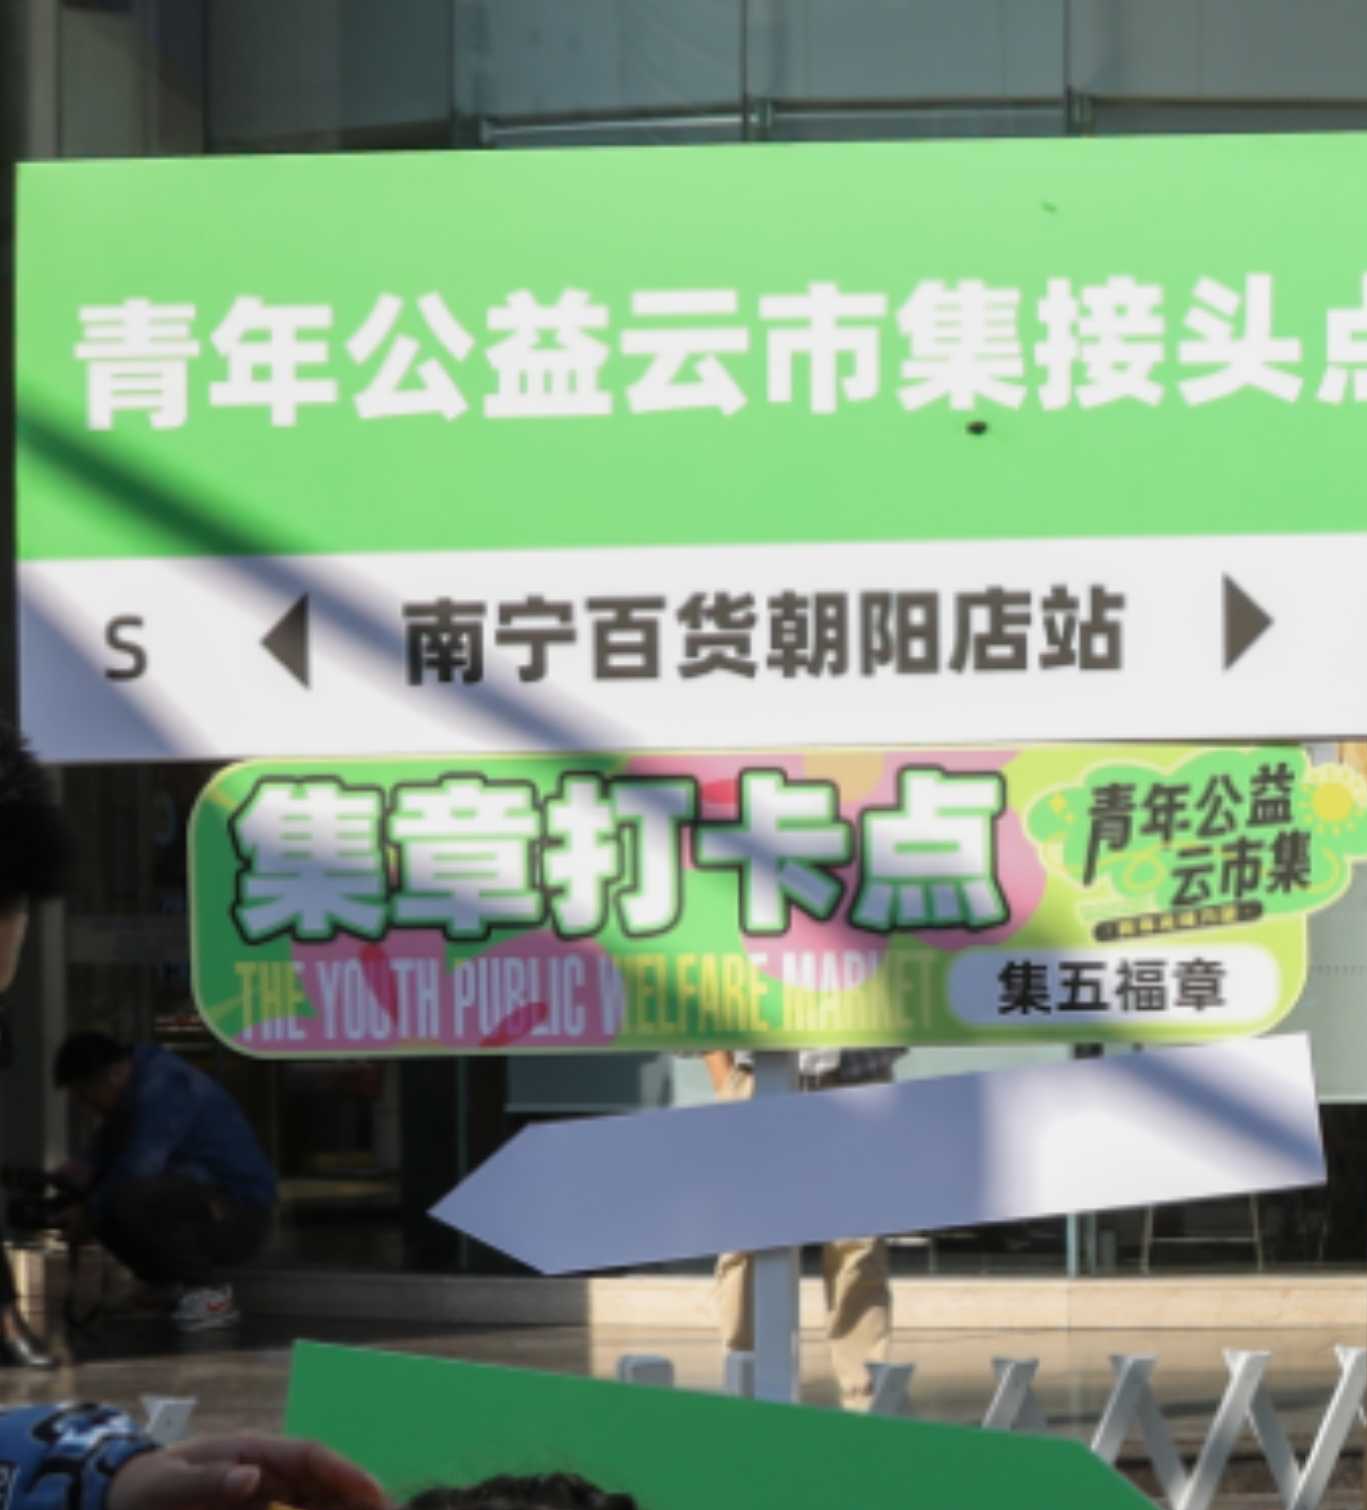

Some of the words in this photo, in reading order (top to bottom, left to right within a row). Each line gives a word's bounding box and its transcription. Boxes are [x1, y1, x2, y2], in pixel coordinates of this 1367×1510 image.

[103, 617, 148, 681] S
[402, 588, 1126, 687] 南宁百货朝阳店站
[230, 765, 1009, 943] 集章打卡点
[1083, 763, 1296, 885] 青年公益
[1170, 829, 1311, 905] 云市集
[235, 961, 302, 1040] THE
[317, 957, 439, 1039] YOUTH
[453, 953, 585, 1037] PUBLIC
[599, 951, 767, 1036] WELFARE
[782, 948, 935, 1032] MARKET
[999, 960, 1226, 1014] 集五福章
